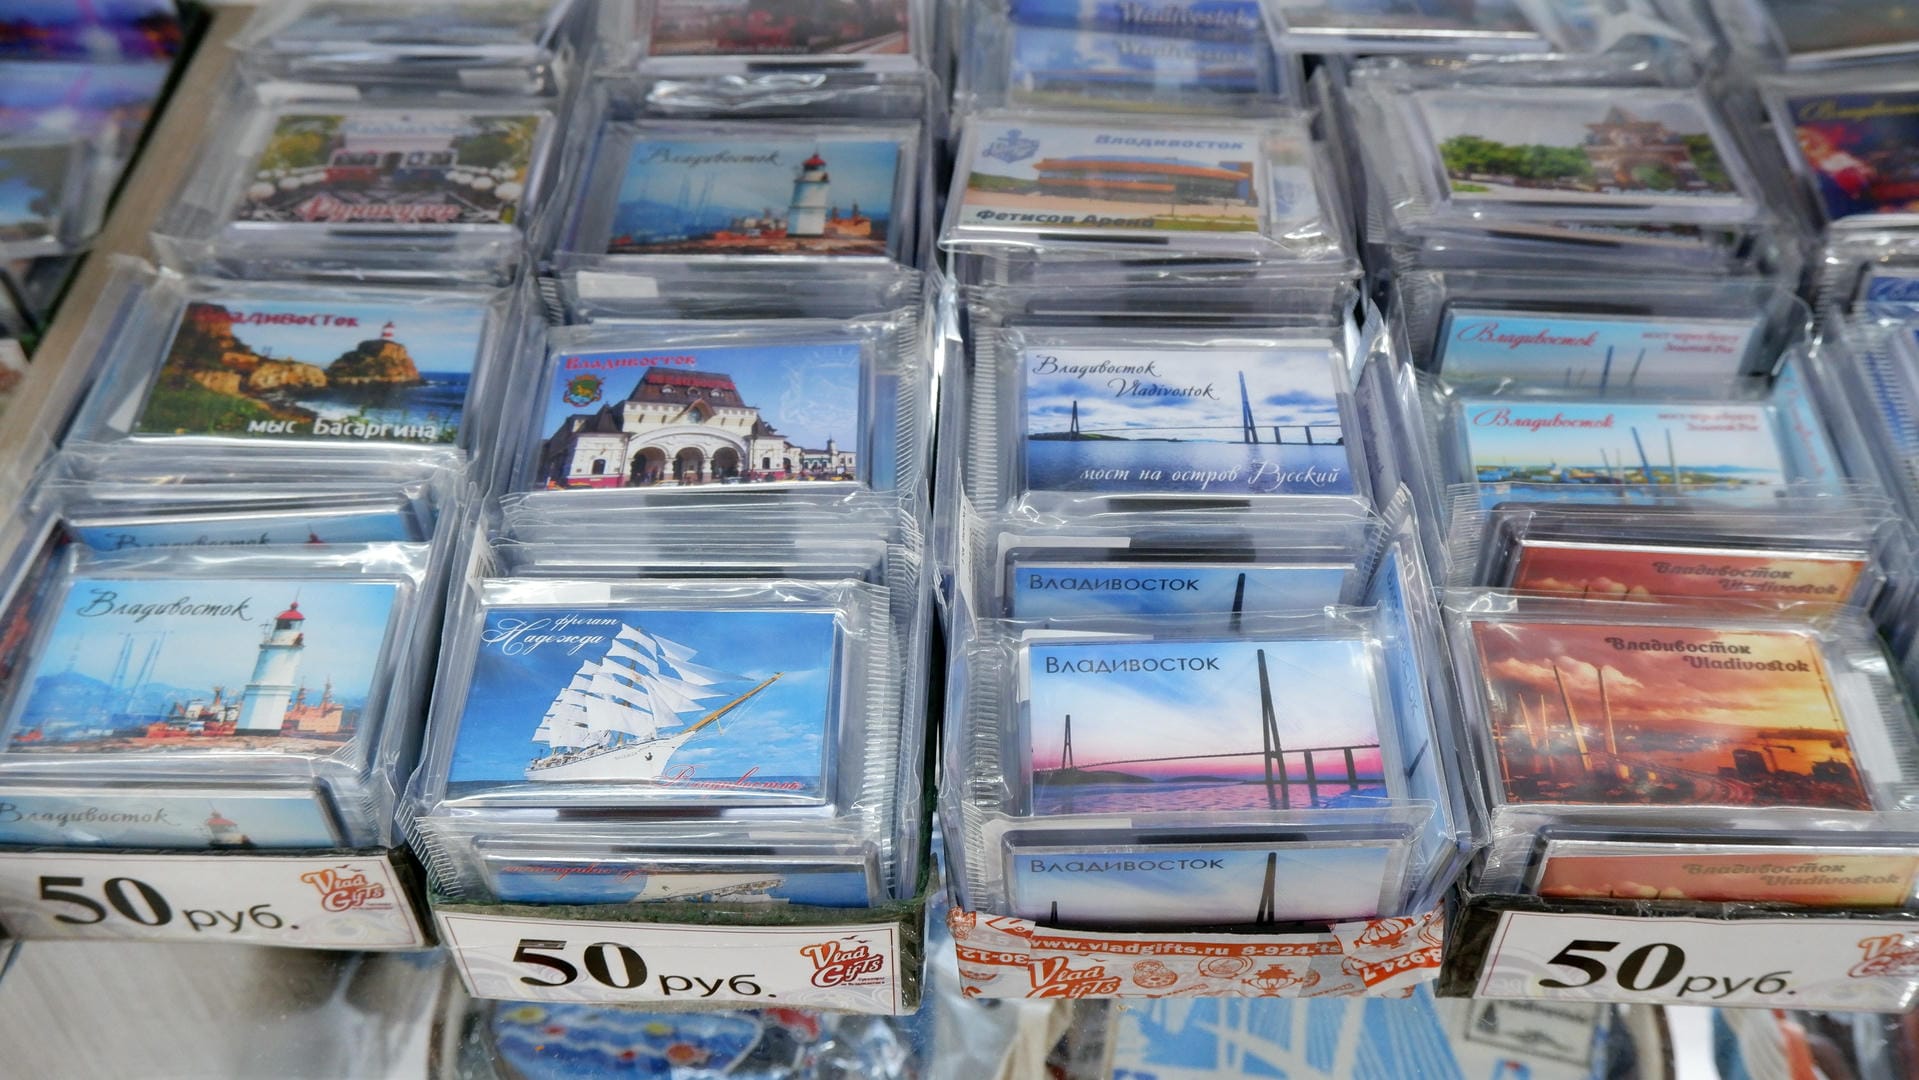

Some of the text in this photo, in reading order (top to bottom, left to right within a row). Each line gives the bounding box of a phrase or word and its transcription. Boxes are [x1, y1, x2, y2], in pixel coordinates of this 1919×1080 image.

[976, 209, 1156, 229] Фетисов Арена
[1457, 321, 1599, 349] Владивосток
[565, 356, 696, 371] Владивосток
[1032, 354, 1162, 379] Владивосток
[1107, 377, 1220, 401] Vladivostok
[248, 417, 438, 440] мыс Басаргина
[1473, 408, 1614, 432] Владивосток
[1079, 460, 1340, 493] мост на остров Русский
[1652, 561, 1793, 579] Владивосток
[1029, 573, 1200, 592] Владивосток
[77, 587, 252, 622] Владивосток
[550, 613, 621, 632] фрегат
[481, 617, 606, 656] Надежда
[1604, 636, 1752, 655] Владивосток
[1045, 656, 1220, 674] Владивосток
[1682, 655, 1811, 672] Vladivostok
[1030, 858, 1225, 873] Владивосток
[1681, 863, 1846, 875] Владивосток
[1760, 874, 1900, 886] Vladivostok
[39, 875, 300, 933] 50 руб.
[800, 941, 869, 970] Vlad
[512, 938, 777, 998] 50 руб.
[1538, 939, 1797, 999] 50 руб.
